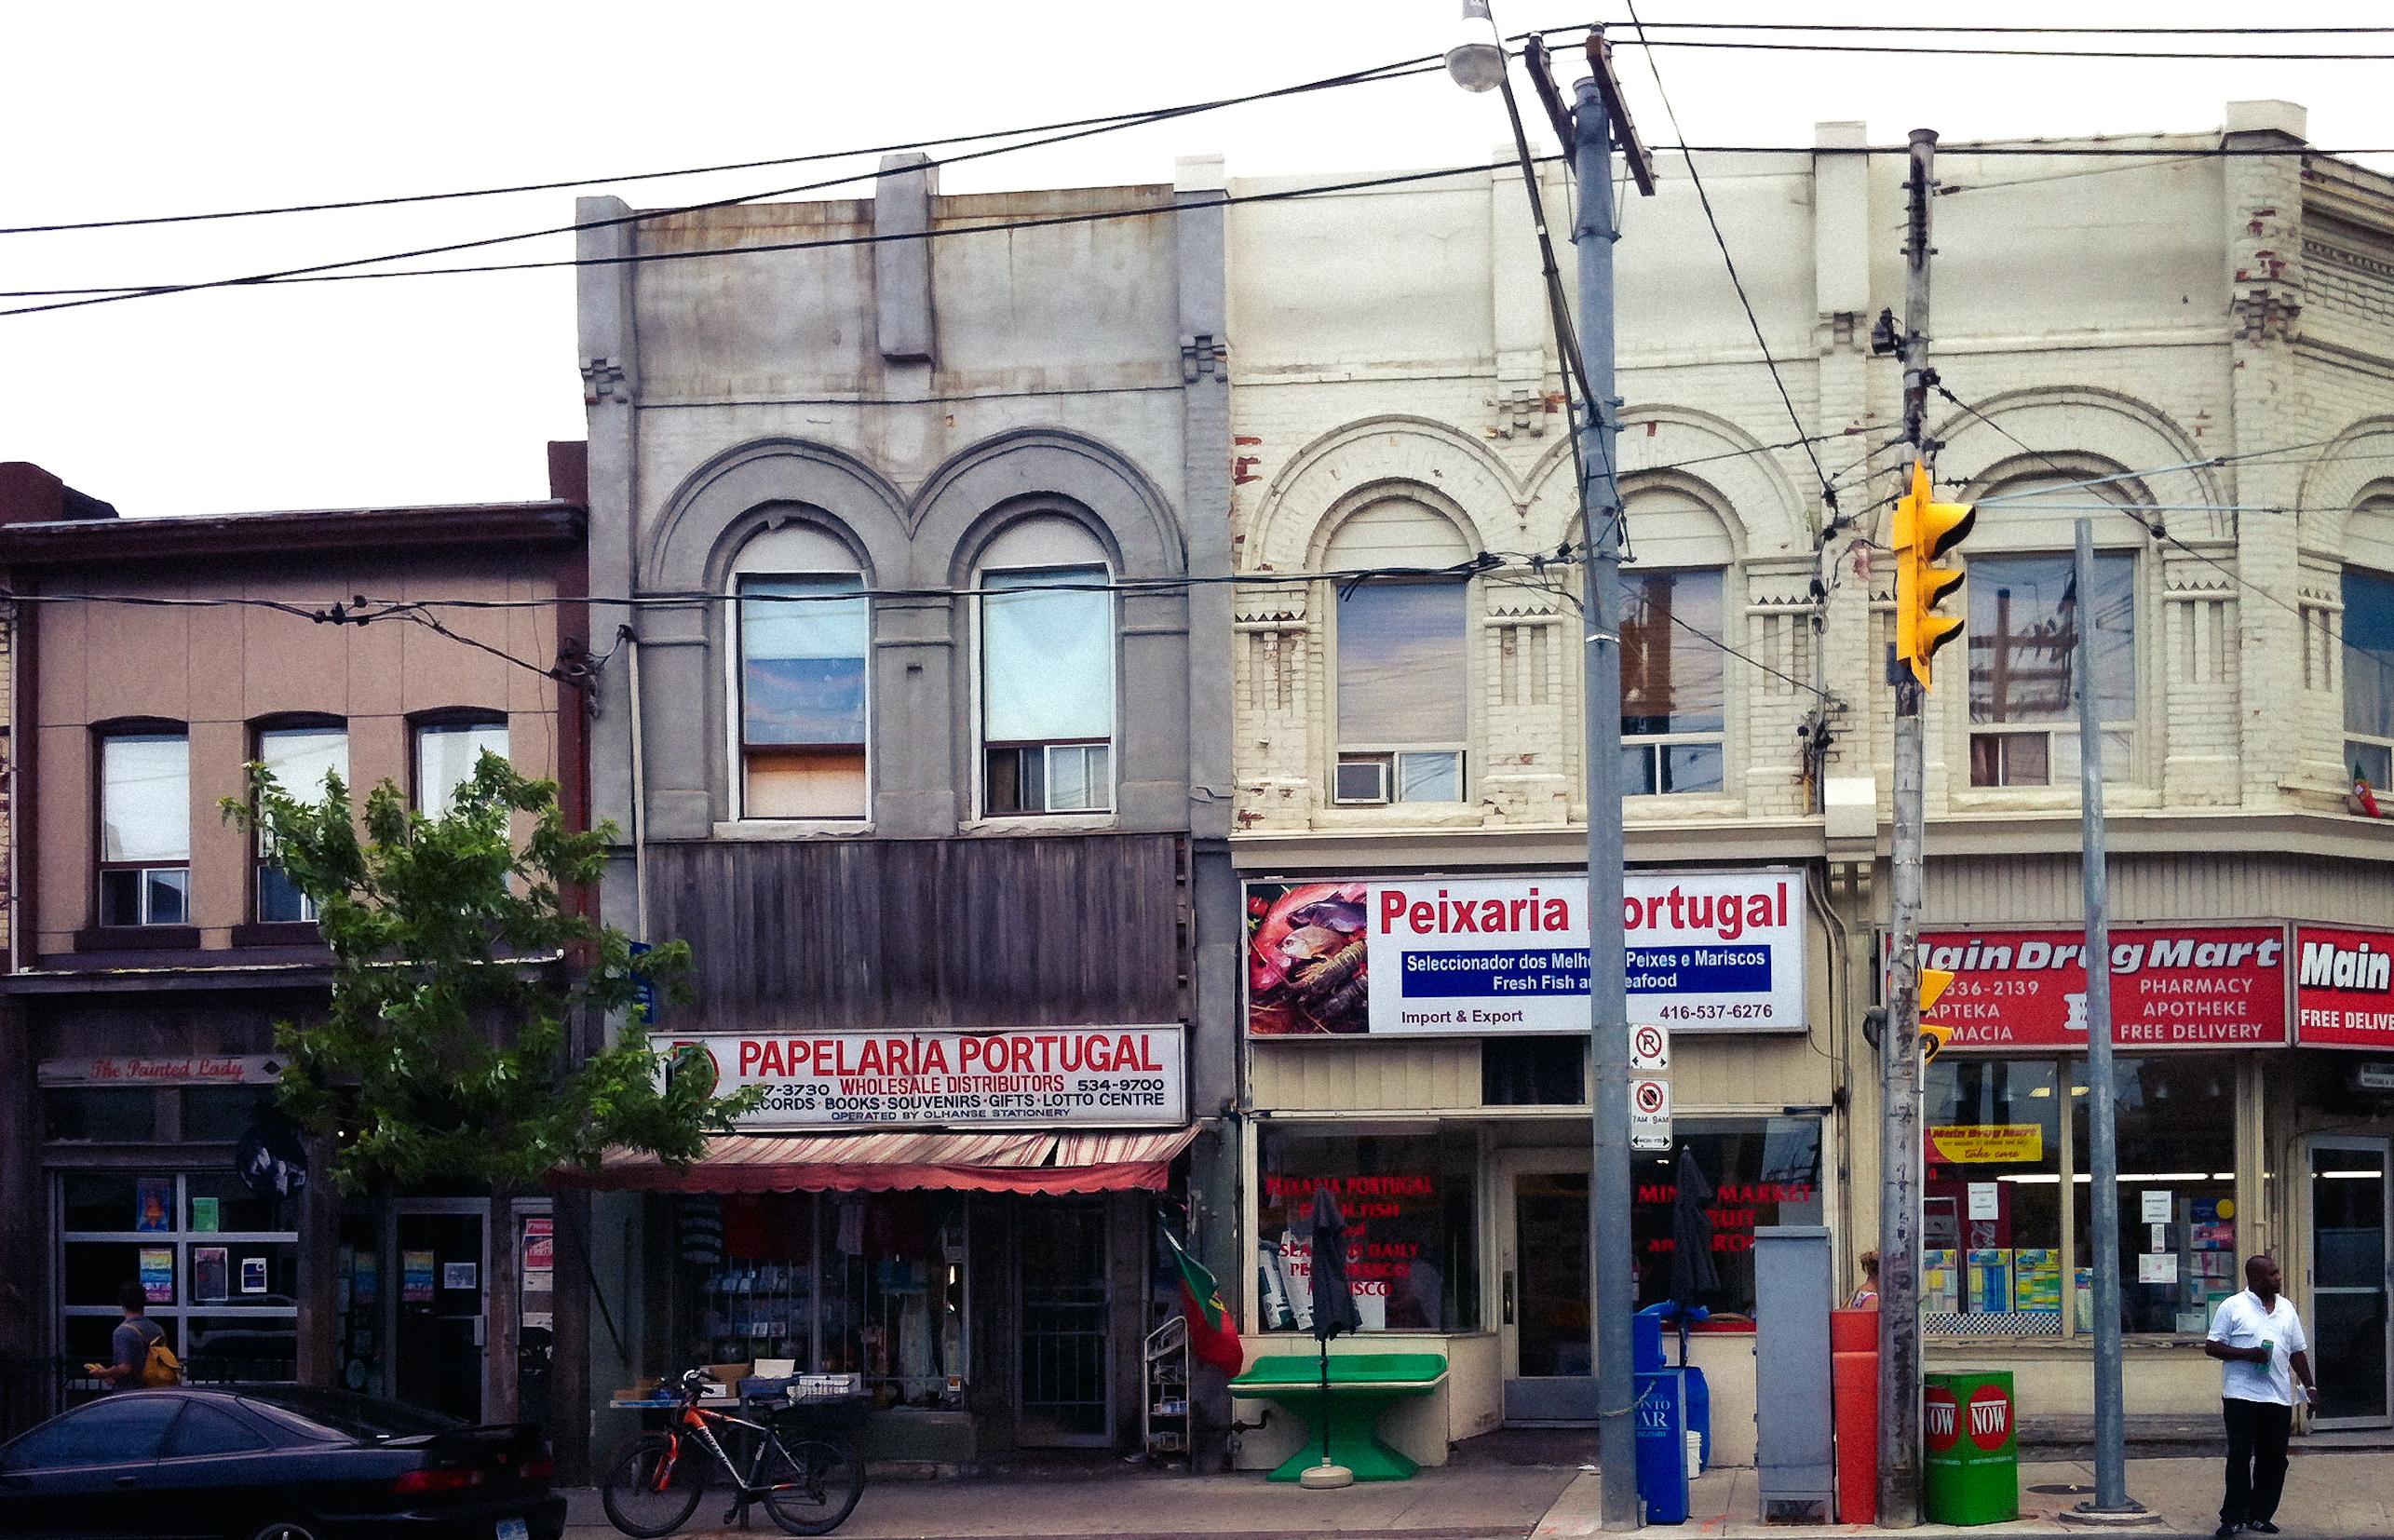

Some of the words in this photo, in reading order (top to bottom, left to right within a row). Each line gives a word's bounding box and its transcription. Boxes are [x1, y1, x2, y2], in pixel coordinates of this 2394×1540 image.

[1381, 887, 1570, 935] Peixaria
[1588, 882, 1787, 939] ortugal
[1407, 953, 1515, 971] Seleccionador
[1520, 952, 1547, 970] dos
[1551, 952, 1590, 970] Melh
[1627, 951, 1677, 968] Peixes
[1681, 954, 1690, 966] e
[1696, 950, 1765, 966] Mariscos
[2016, 940, 2144, 975] Drg
[2148, 938, 2282, 968] Mart
[2299, 941, 2391, 990] Main
[1493, 975, 1537, 991] Fresh
[1541, 974, 1575, 990] Fish
[1624, 972, 1678, 988] eafood
[2140, 978, 2253, 994] PHARMACY
[1401, 1010, 1452, 1026] Import
[1455, 1009, 1467, 1023] &
[1472, 1009, 1523, 1025] Export
[1659, 1004, 1773, 1020] 416-537-6276
[1925, 1003, 2000, 1019] APTEKA
[2143, 1000, 2248, 1017] APOTHEKE
[2301, 1008, 2340, 1029] FREE
[2345, 1010, 2394, 1031] DELIVE
[1949, 1025, 2013, 1042] MACIA
[2120, 1023, 2164, 1040] FREE
[2172, 1022, 2263, 1039] DELIVERY
[739, 1037, 951, 1077] PAPELARIA
[959, 1034, 1163, 1074] PORTUGAL
[740, 1083, 831, 1097] 7-3730
[840, 1076, 940, 1096] WHOLESALE
[947, 1074, 1064, 1094] DISTRIBUTORS
[1077, 1078, 1164, 1092] 534-9700
[751, 1096, 816, 1111] CORDS
[825, 1096, 880, 1111] BOOKS
[887, 1094, 981, 1111] SOUVENIRS
[988, 1093, 1035, 1108] GIFTS
[1043, 1092, 1094, 1107] LOTTO
[1099, 1091, 1165, 1106] CENTRE
[832, 1112, 898, 1121] OPERATED
[902, 1111, 918, 1121] BY
[992, 1108, 1071, 1118] STATIONERY
[1970, 1405, 2007, 1436] NOW
